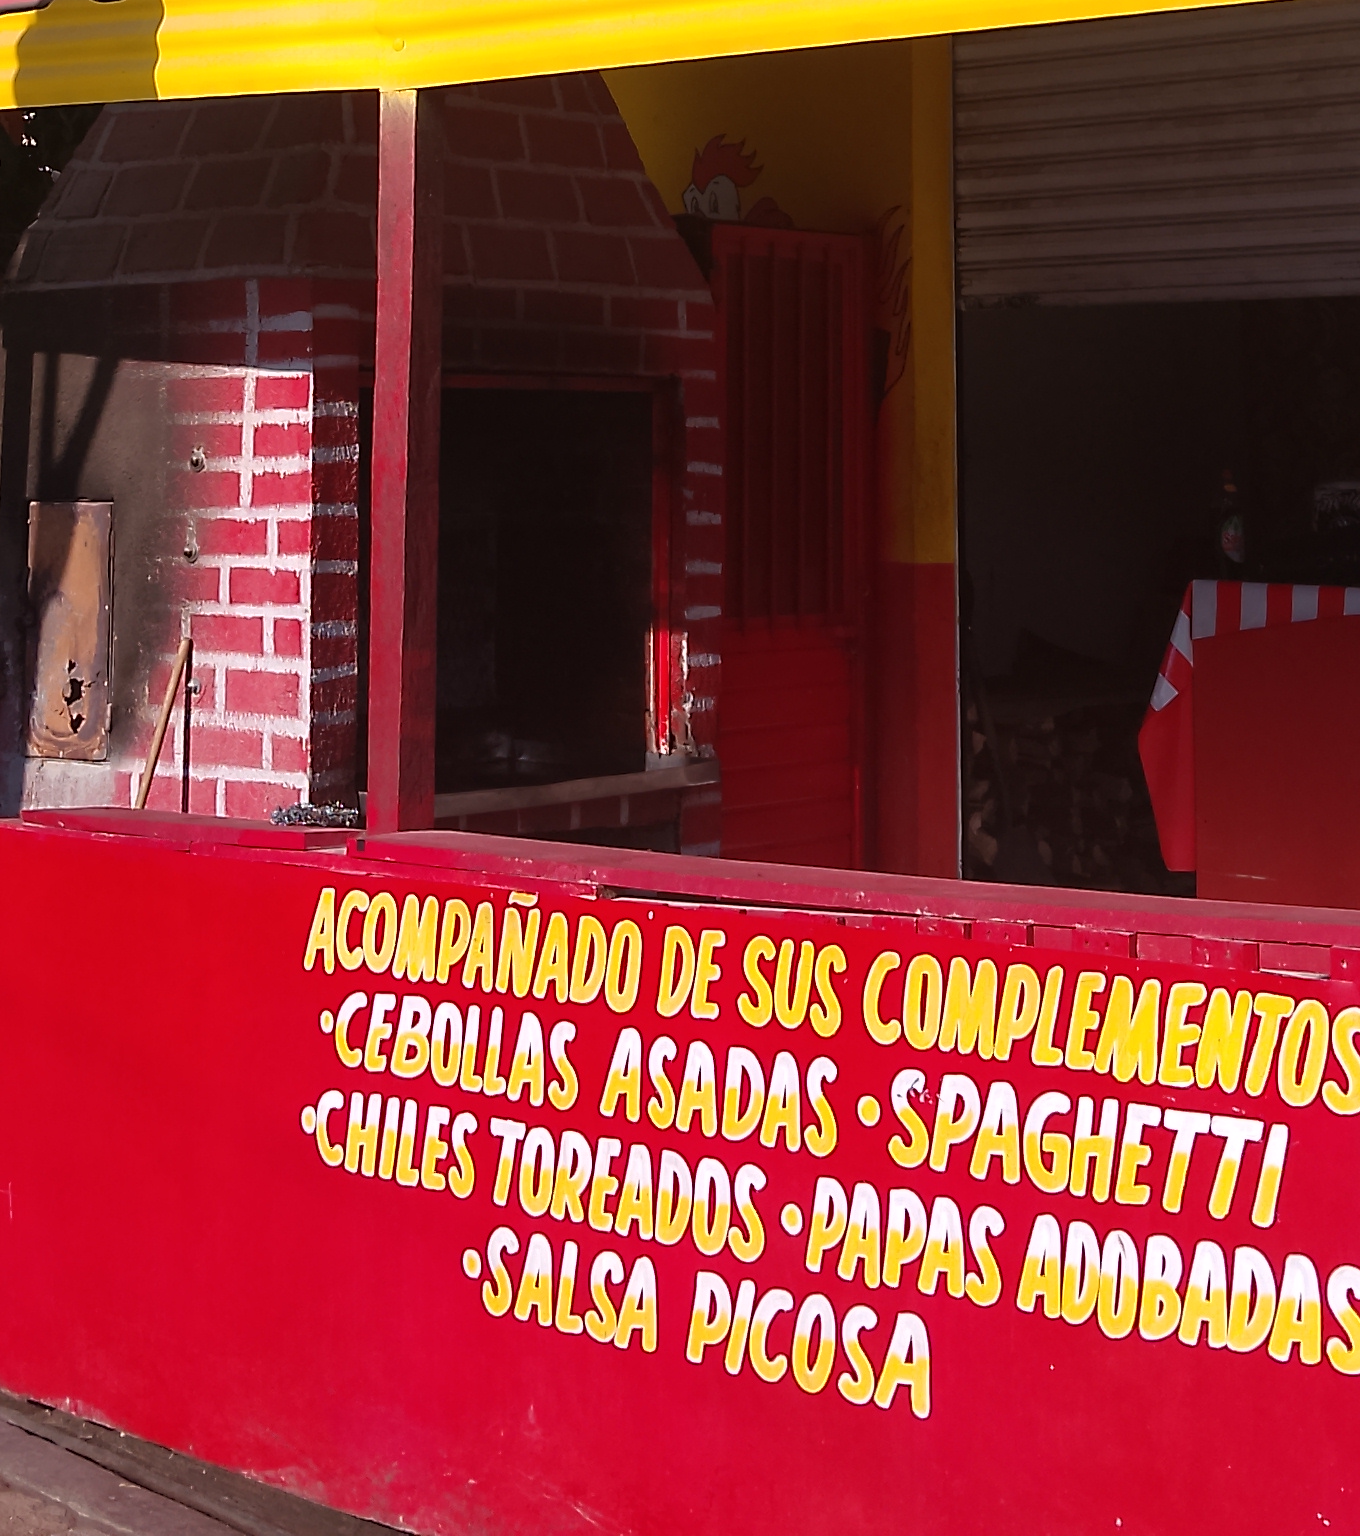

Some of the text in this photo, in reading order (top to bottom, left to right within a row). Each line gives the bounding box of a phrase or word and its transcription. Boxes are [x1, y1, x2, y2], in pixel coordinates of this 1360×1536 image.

[304, 887, 642, 1013] ACOMPAÑADO
[657, 925, 725, 1019] DE
[738, 935, 847, 1037] SUS
[315, 1089, 477, 1199] CHILES
[490, 1118, 767, 1262] TOREADOS
[806, 1176, 1005, 1306] PAPAS
[335, 992, 1289, 1228] CEBOLLAS ASADAS SPAGHETTI
[481, 1226, 931, 1418] SALSA PICOSA
